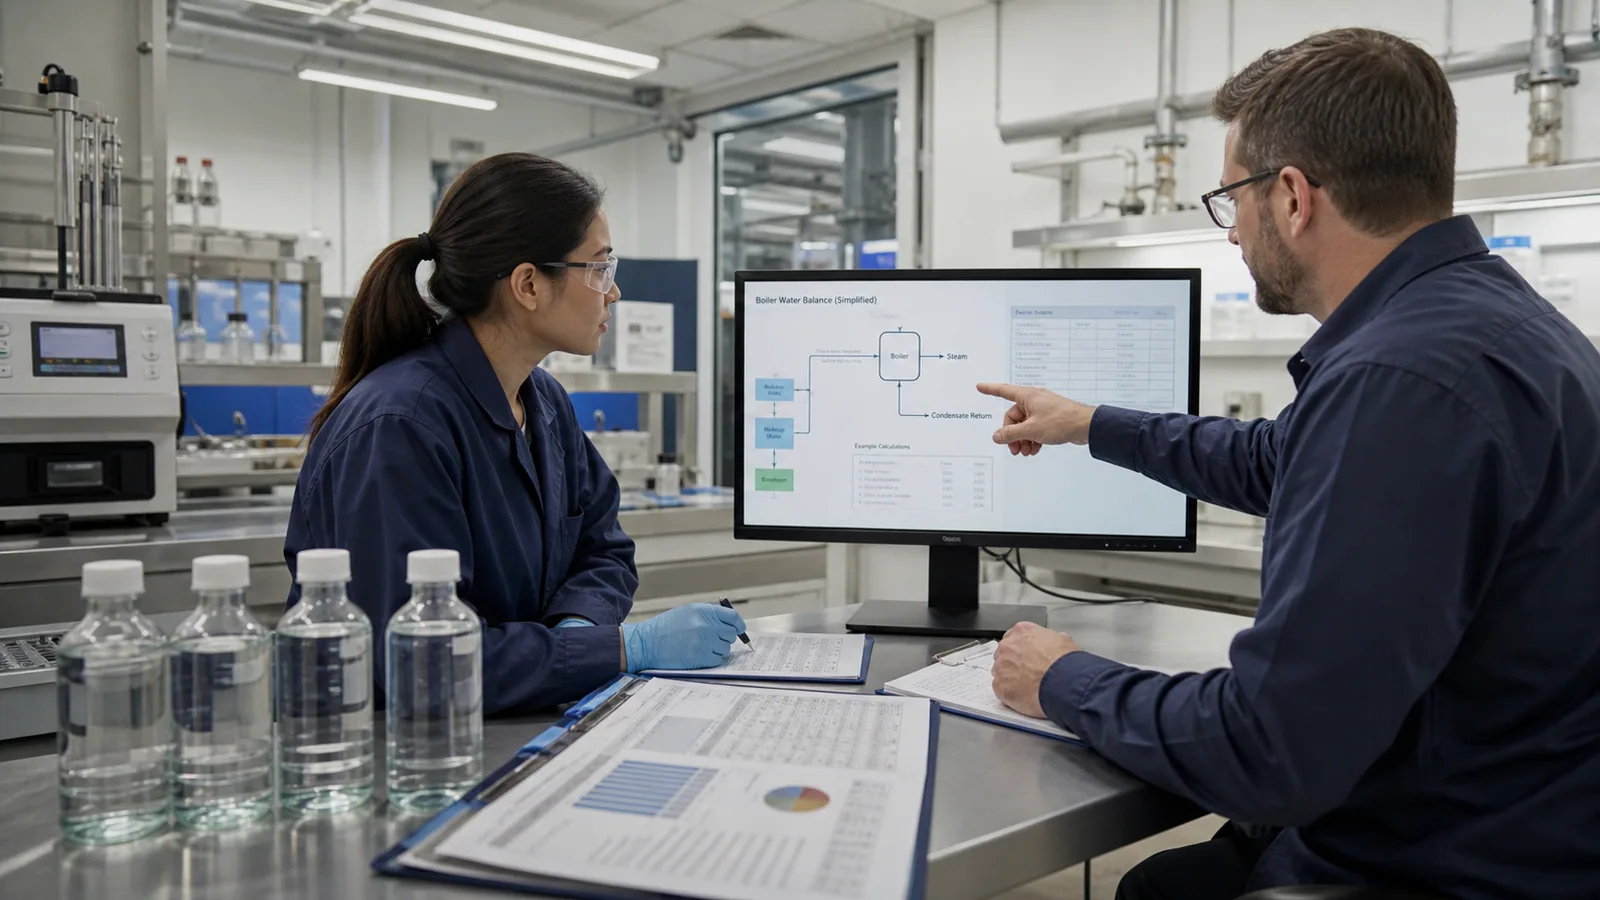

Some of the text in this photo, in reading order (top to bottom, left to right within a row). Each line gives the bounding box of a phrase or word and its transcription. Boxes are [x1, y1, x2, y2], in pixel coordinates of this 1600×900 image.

[756, 296, 877, 305] Boiler Water Balance (Simplified)
